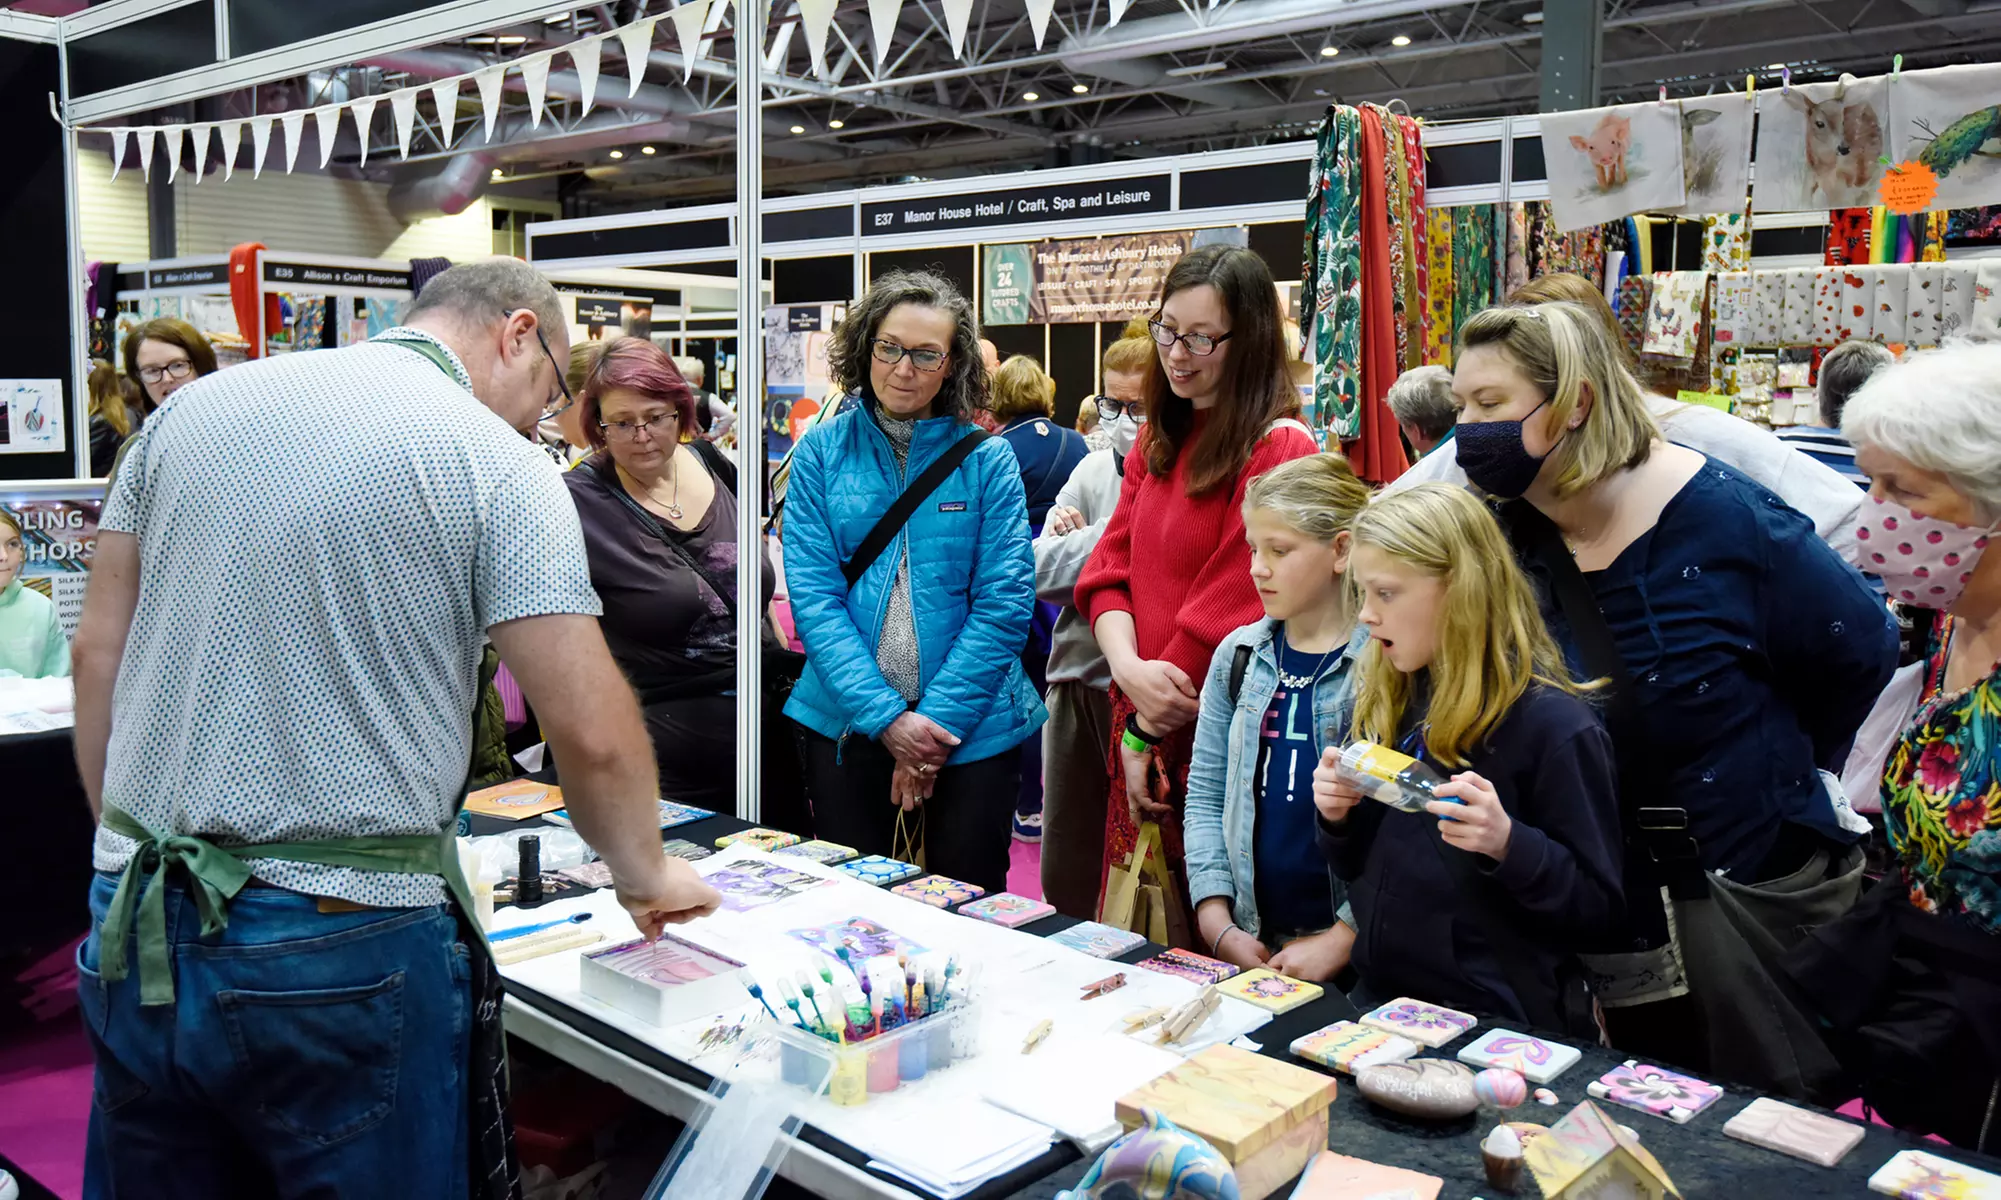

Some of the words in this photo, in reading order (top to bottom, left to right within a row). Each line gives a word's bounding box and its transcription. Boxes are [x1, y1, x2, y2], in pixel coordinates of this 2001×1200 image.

[875, 213, 894, 226] E37
[904, 211, 936, 223] Manor
[939, 207, 972, 220] House
[975, 202, 1004, 217] Hotel
[1007, 200, 1014, 215] /
[1018, 199, 1049, 213] Craft,
[1053, 196, 1076, 211] Spa
[1080, 193, 1102, 208] and
[1106, 190, 1151, 205] Leisure
[1037, 253, 1055, 265] The
[1058, 251, 1090, 263] Manor
[1092, 250, 1101, 261] &
[1103, 246, 1147, 261] Ashbury
[1148, 243, 1183, 257] Hotels
[275, 267, 294, 279] E35
[304, 269, 332, 281] Allison
[343, 272, 365, 282] Craft
[367, 274, 408, 286] Emporium
[1046, 266, 1058, 275] ON
[1060, 264, 1074, 274] THE
[1076, 262, 1115, 273] FOOTHILLS
[1117, 261, 1128, 272] OF
[1129, 260, 1170, 271] DARTMOOR
[1038, 281, 1066, 290] LEISURE
[1074, 280, 1097, 289] CRAFT
[1105, 279, 1121, 288] SPA
[1128, 276, 1152, 286] SPORT
[23, 541, 97, 561] HOPS
[58, 588, 75, 596] SILK
